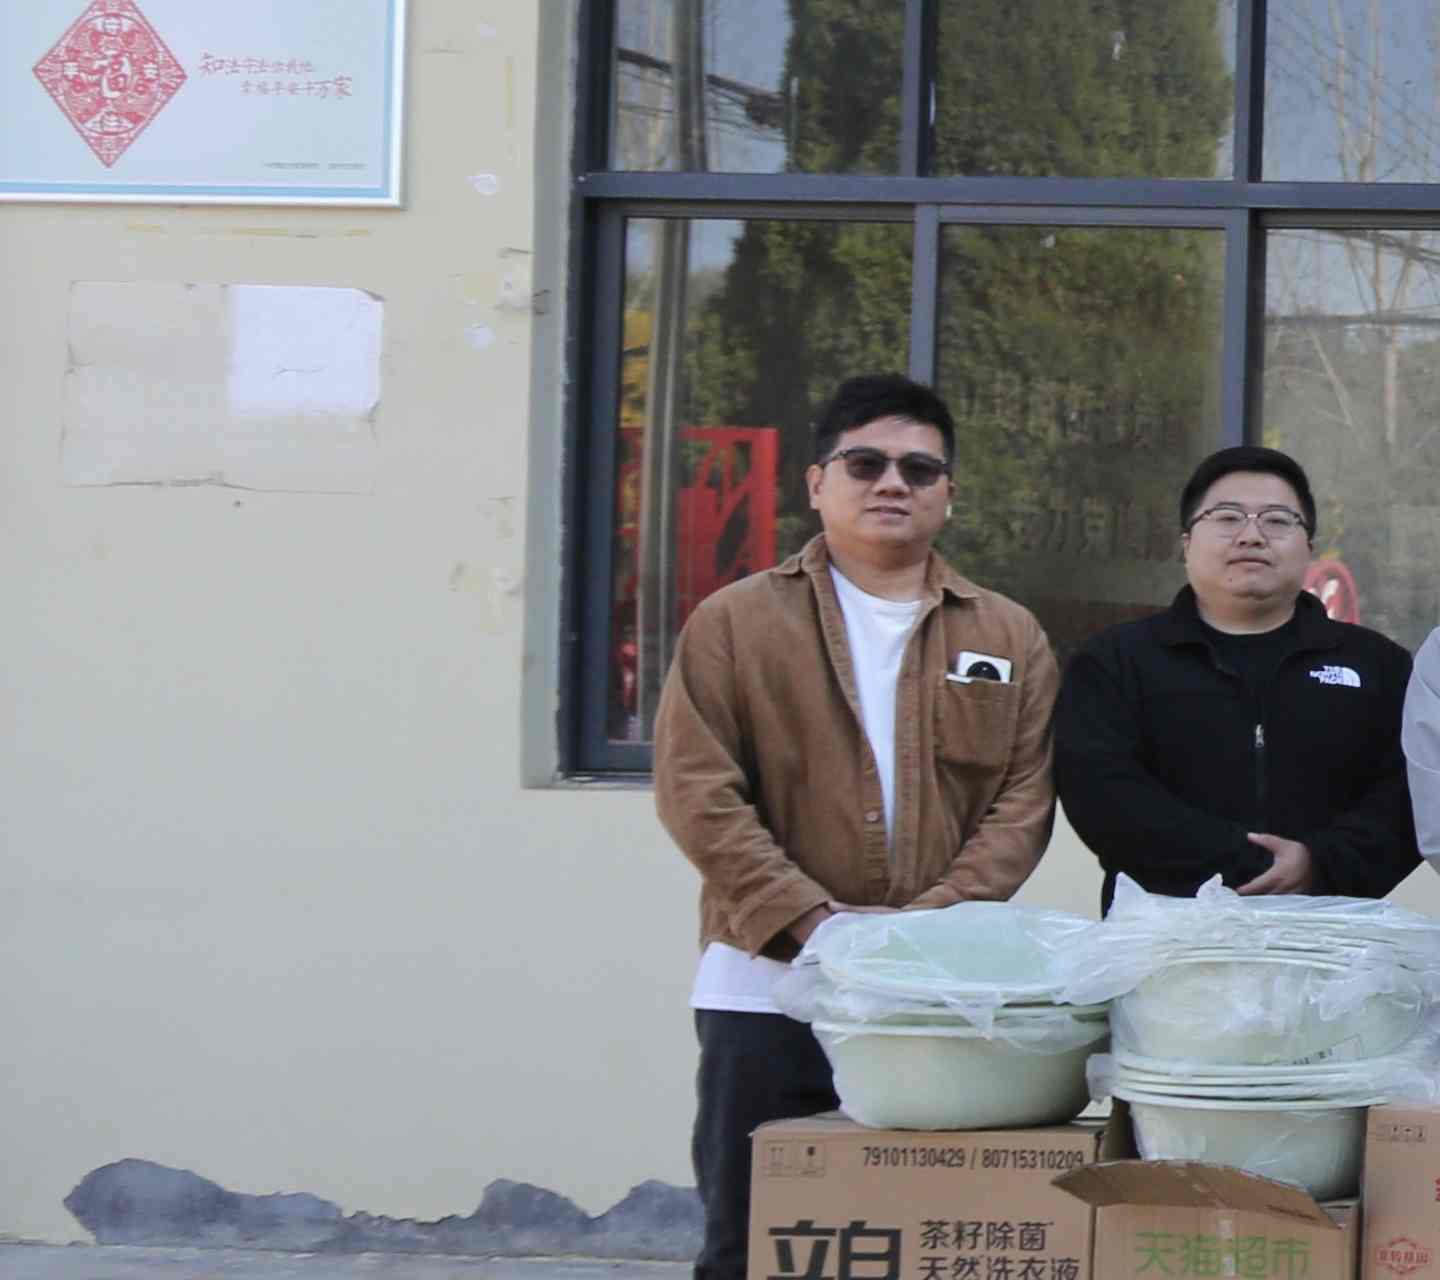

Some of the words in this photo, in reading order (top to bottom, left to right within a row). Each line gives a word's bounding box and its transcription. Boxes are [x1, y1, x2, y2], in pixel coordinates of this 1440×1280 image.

[863, 1147, 966, 1170] 79101130429
[982, 1147, 1085, 1170] 80715310209
[919, 1220, 1050, 1252] 茶籽除菌
[1134, 1231, 1312, 1280] 天猫超市
